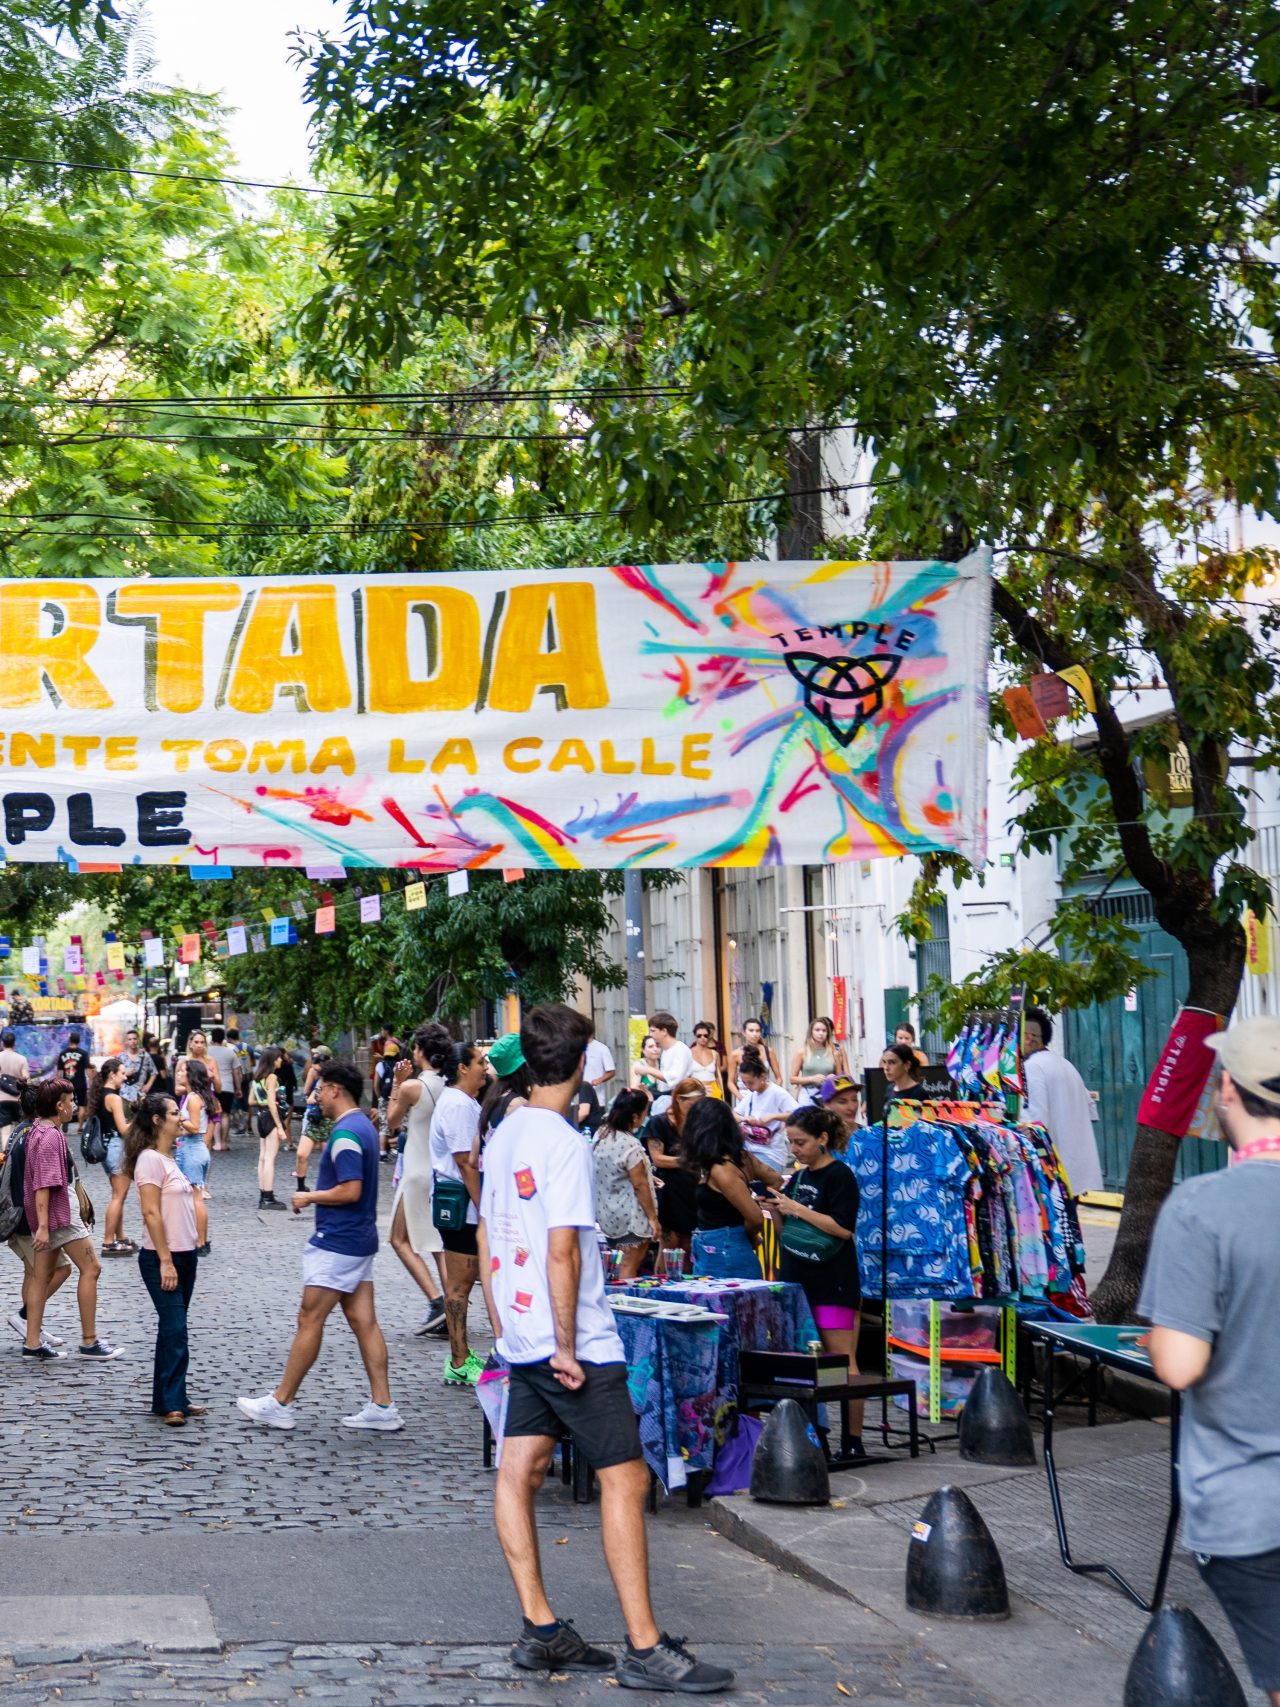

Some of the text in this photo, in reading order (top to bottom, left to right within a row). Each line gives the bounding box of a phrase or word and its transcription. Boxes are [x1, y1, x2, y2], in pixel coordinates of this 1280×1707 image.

[770, 620, 917, 653] TEMPLE
[160, 736, 356, 777] TOMA
[387, 737, 479, 777] LA
[503, 732, 715, 781] CALLE
[1150, 1047, 1179, 1105] TEMPLE
